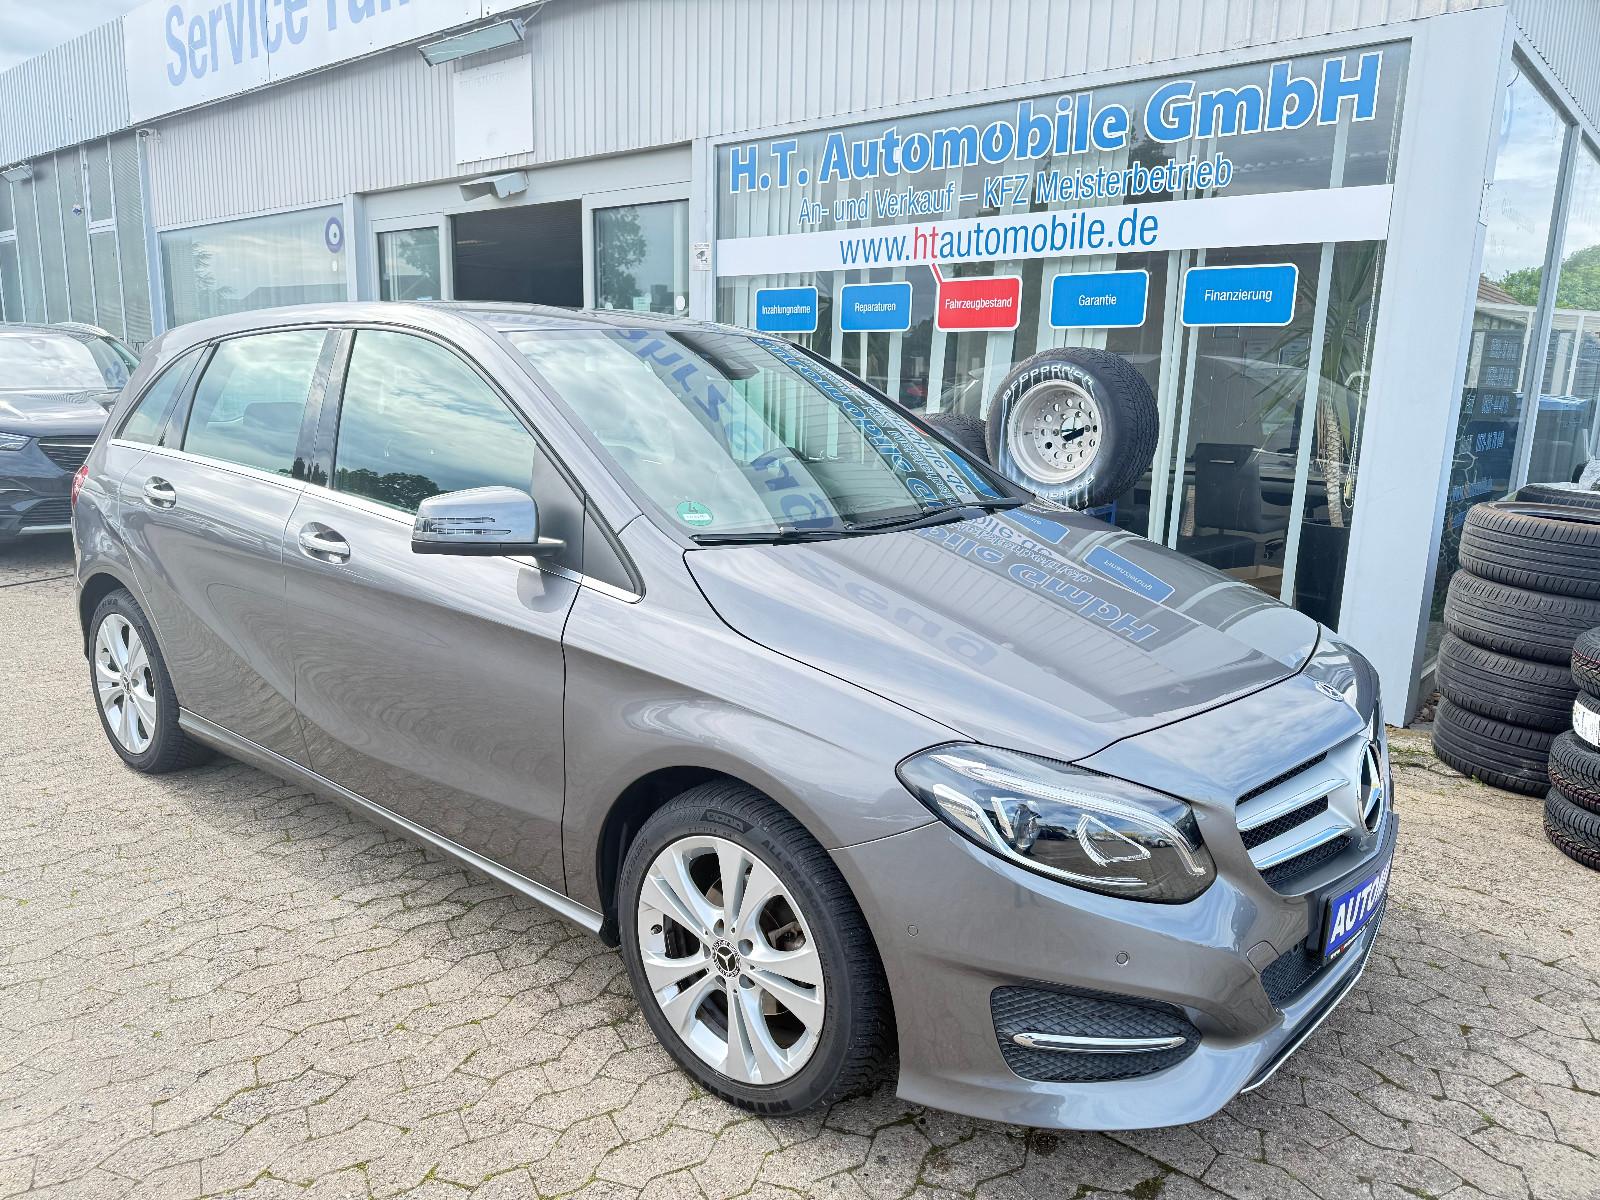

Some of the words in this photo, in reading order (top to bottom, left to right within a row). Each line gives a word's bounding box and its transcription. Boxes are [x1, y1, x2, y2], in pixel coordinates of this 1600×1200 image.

[165, 0, 308, 87] Service
[729, 139, 810, 194] H.T.
[817, 91, 1130, 184] Automobile
[1143, 50, 1384, 144] GmbH
[798, 197, 830, 225] An-
[833, 191, 870, 222] und
[874, 181, 956, 217] Verkauf
[983, 174, 1029, 209] KFZ
[1035, 152, 1234, 204] Meisterbetrieb
[840, 208, 1159, 264] www.htautomobile.de
[1078, 294, 1117, 307] Garantie
[1204, 288, 1273, 303] Finanzierung
[761, 303, 811, 315] Inzahlungnahme
[854, 301, 897, 314] Reparaturen
[945, 296, 1013, 311] Fahrzeugbestand
